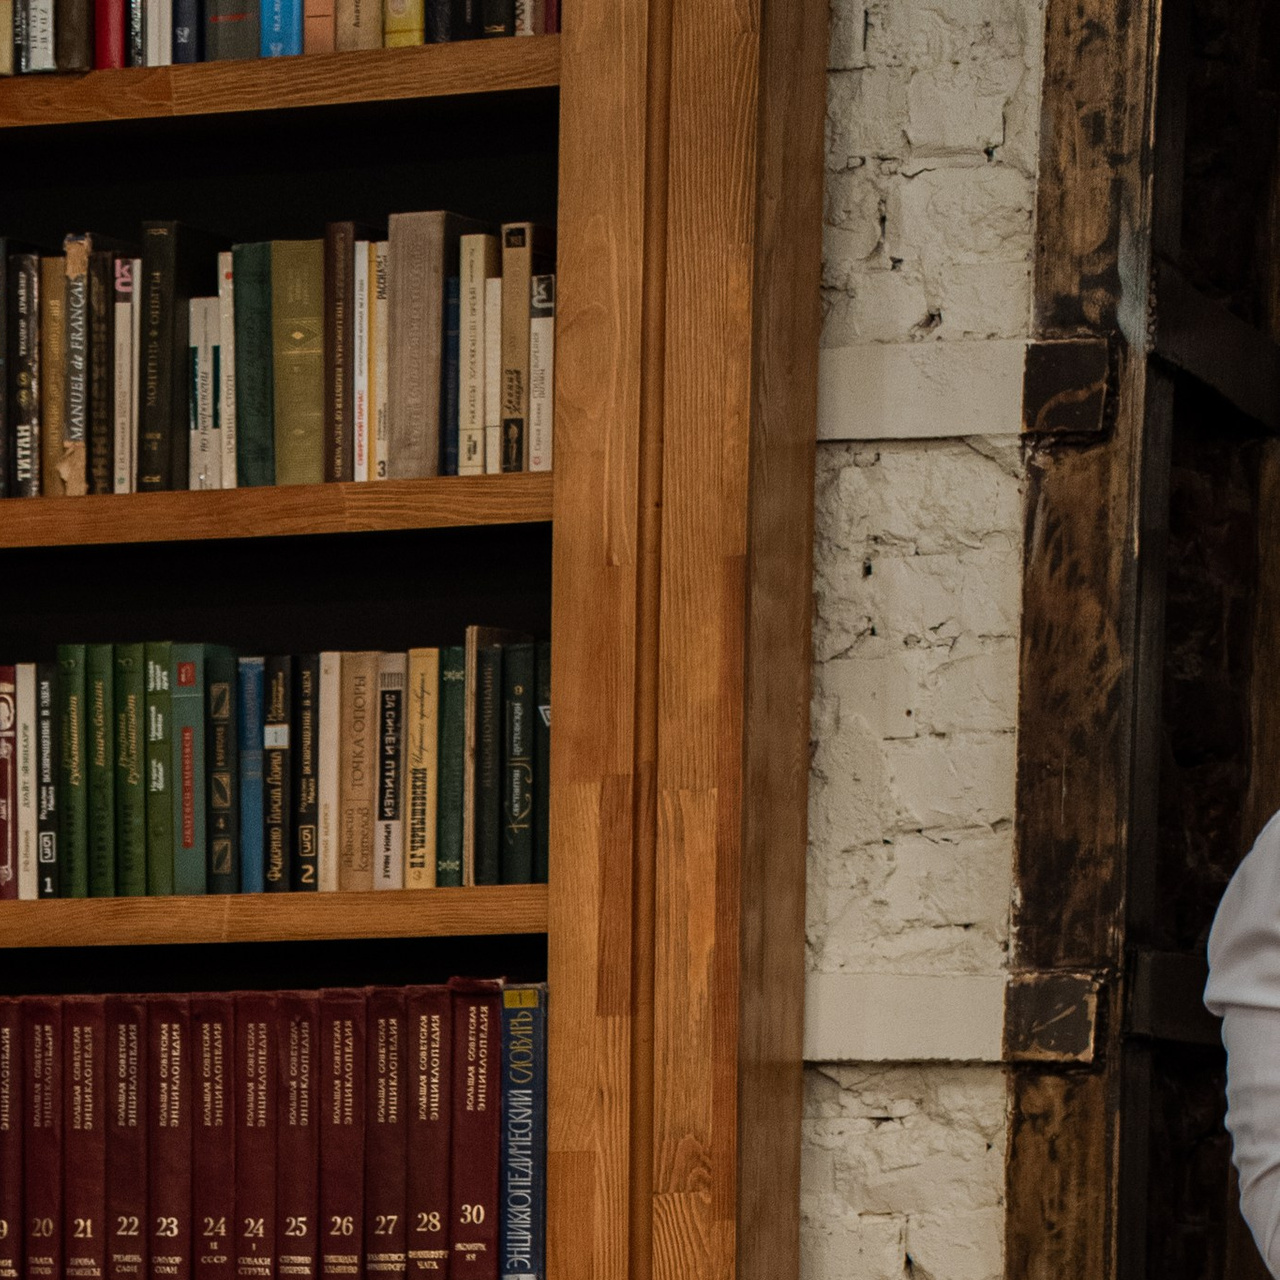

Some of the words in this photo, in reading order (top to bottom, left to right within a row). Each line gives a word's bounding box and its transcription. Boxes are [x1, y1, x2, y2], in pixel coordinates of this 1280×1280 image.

[17, 270, 28, 315] ДРАЙЗЕР
[149, 270, 162, 324] ОПЫТЫ
[18, 318, 28, 357] ТЕОДОР
[69, 354, 84, 370] de
[146, 340, 159, 406] МОНТЕНЬ
[69, 373, 85, 441] MANUEL
[333, 367, 345, 409] REGISTER
[16, 424, 32, 481] ТИТАН
[333, 424, 344, 446] NEW
[333, 447, 344, 478] WORDS
[376, 459, 388, 477] 3
[351, 674, 367, 733] ОПОРЫ
[384, 693, 396, 707] ЗА
[383, 710, 396, 757] СИНЕЙ
[266, 751, 282, 786] ЛОРКА
[350, 738, 365, 791] ТОЧКА
[382, 760, 396, 818] ПТИЦЕЙ
[410, 767, 427, 852] ЧЕРНЫШЕВСКИЙ
[383, 823, 391, 853] ИРИНА
[301, 864, 316, 883] 2
[159, 1022, 169, 1079] СОВЕТСКАЯ
[202, 1022, 212, 1078] СОВЕТСКАЯ
[377, 1018, 386, 1074] СОВЕТСКАЯ
[418, 1014, 428, 1071] СОВЕТСКАЯ
[466, 1005, 476, 1062] СОВЕТСКАЯ
[508, 1010, 535, 1084] СЛОВАРЬ
[170, 1023, 181, 1128] ЭНЦИКЛОПЕДИЯ
[214, 1022, 223, 1127] ЭНЦИКЛОПЕДИЯ
[388, 1017, 398, 1124] ЭНЦИКЛОПЕДИЯ
[430, 1013, 440, 1121] ЭНЦИКЛОПЕДИЯ
[478, 1005, 488, 1112] ЭНЦИКЛОПЕДИЯ
[159, 1081, 169, 1127] БОЛЬШАЯ
[202, 1081, 212, 1127] БОЛЬШАЯ
[377, 1077, 386, 1124] БОЛЬШАЯ
[418, 1074, 428, 1121] БОЛЬШАЯ
[466, 1065, 476, 1112] БОЛЬШАЯ
[506, 1089, 534, 1270] ЭНЦИКЛОПЕДИЧЕСКИЙ
[33, 1218, 54, 1238] 20
[75, 1219, 93, 1238] 21
[117, 1216, 140, 1236] 22
[157, 1217, 179, 1238] 23
[204, 1217, 226, 1237] 24
[245, 1218, 265, 1238] 24
[286, 1217, 308, 1237] 25
[331, 1216, 354, 1236] 26
[376, 1215, 398, 1235] 27
[417, 1212, 442, 1232] 28
[460, 1204, 485, 1225] 30
[200, 1255, 227, 1263] СССР
